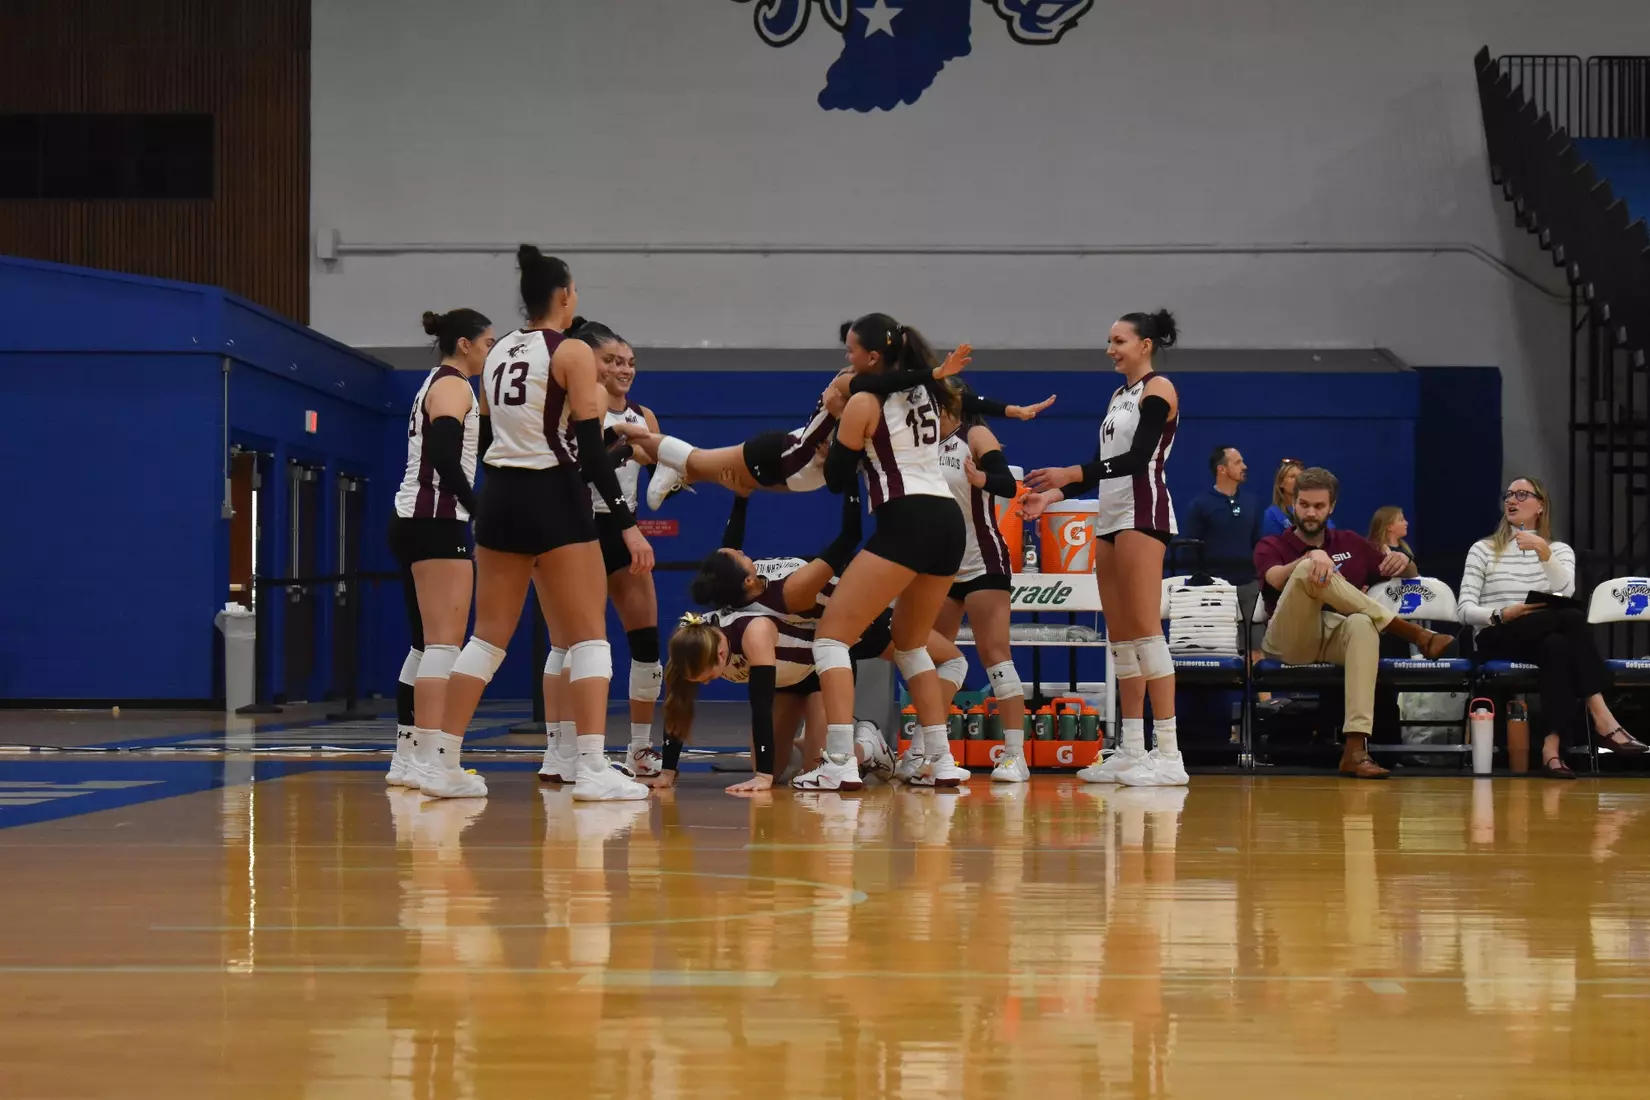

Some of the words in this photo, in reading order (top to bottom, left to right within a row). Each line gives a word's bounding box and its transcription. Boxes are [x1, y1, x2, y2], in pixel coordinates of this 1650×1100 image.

[492, 361, 529, 406] 13
[906, 403, 937, 447] 15
[1102, 416, 1115, 443] 14
[1064, 520, 1086, 546] G
[1331, 551, 1352, 562] SIU
[1384, 584, 1437, 603] Sycamores
[1611, 586, 1650, 605] Sycamo
[968, 722, 979, 736] G
[1035, 722, 1044, 736] G
[1056, 745, 1073, 764] G
